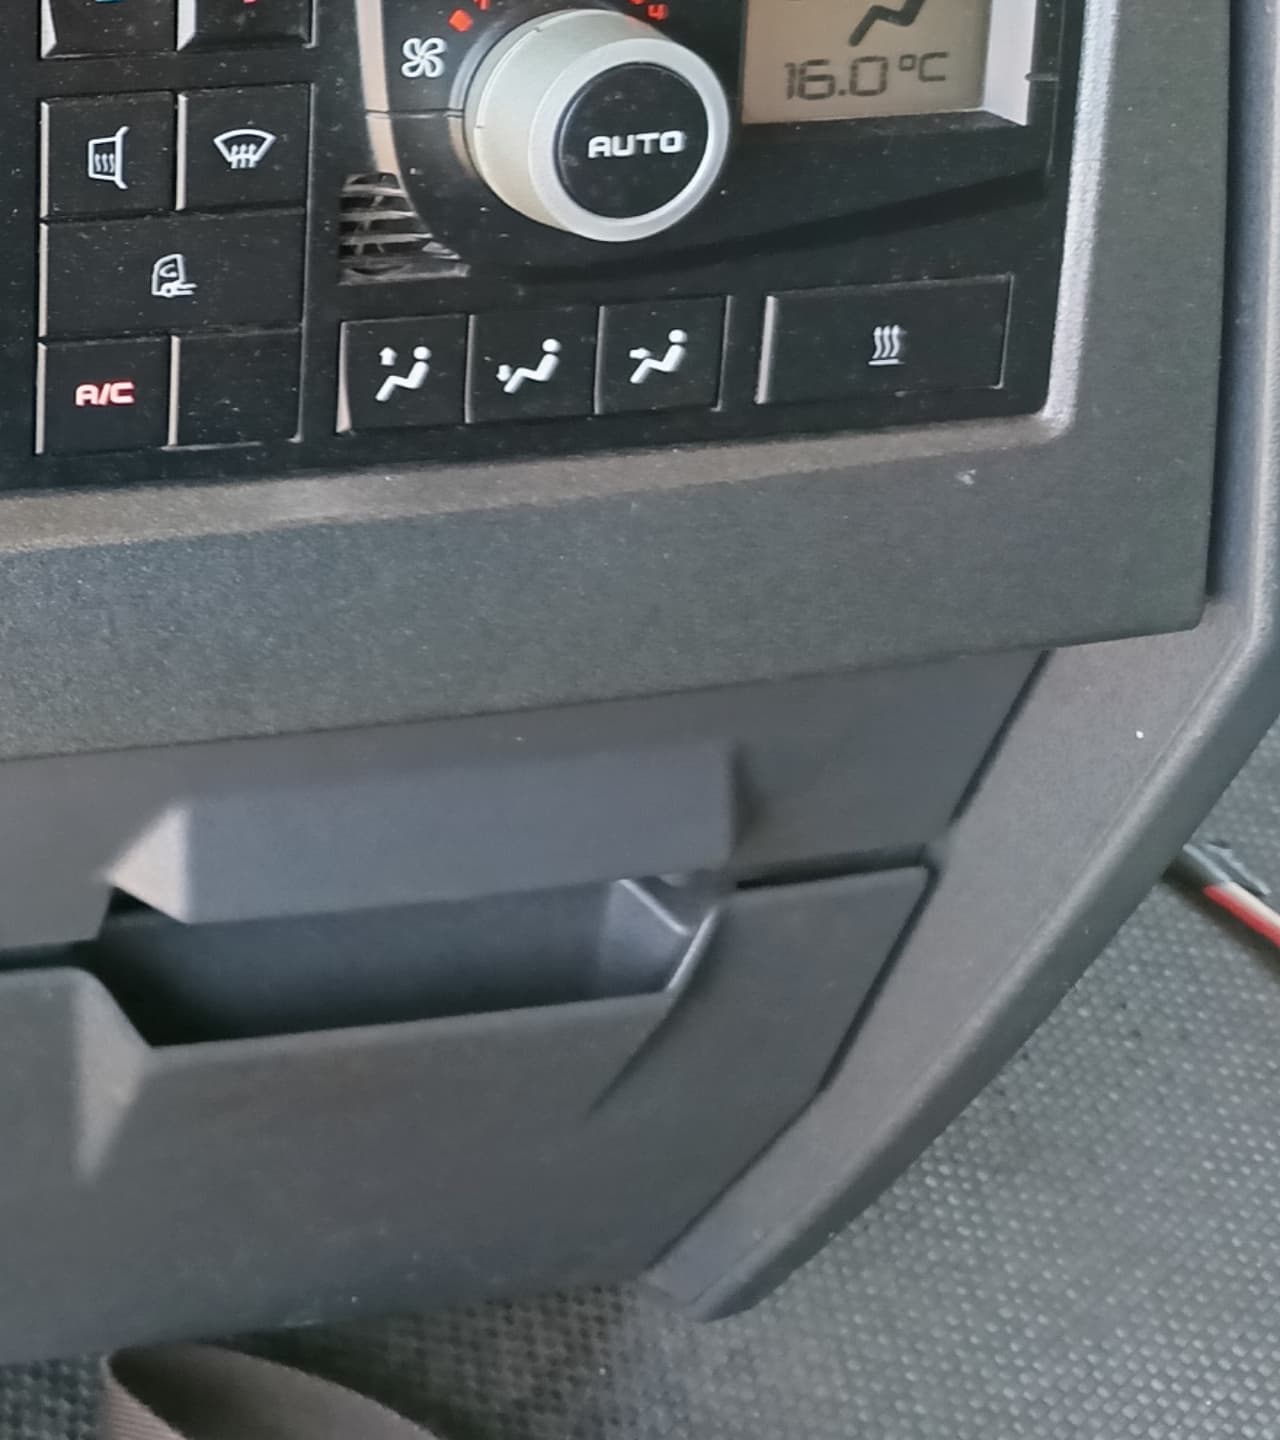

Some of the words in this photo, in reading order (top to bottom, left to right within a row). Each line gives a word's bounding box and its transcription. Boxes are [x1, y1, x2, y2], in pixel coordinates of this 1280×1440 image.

[648, 4, 668, 21] 4
[587, 130, 686, 159] AUTO
[74, 380, 135, 407] A/C
